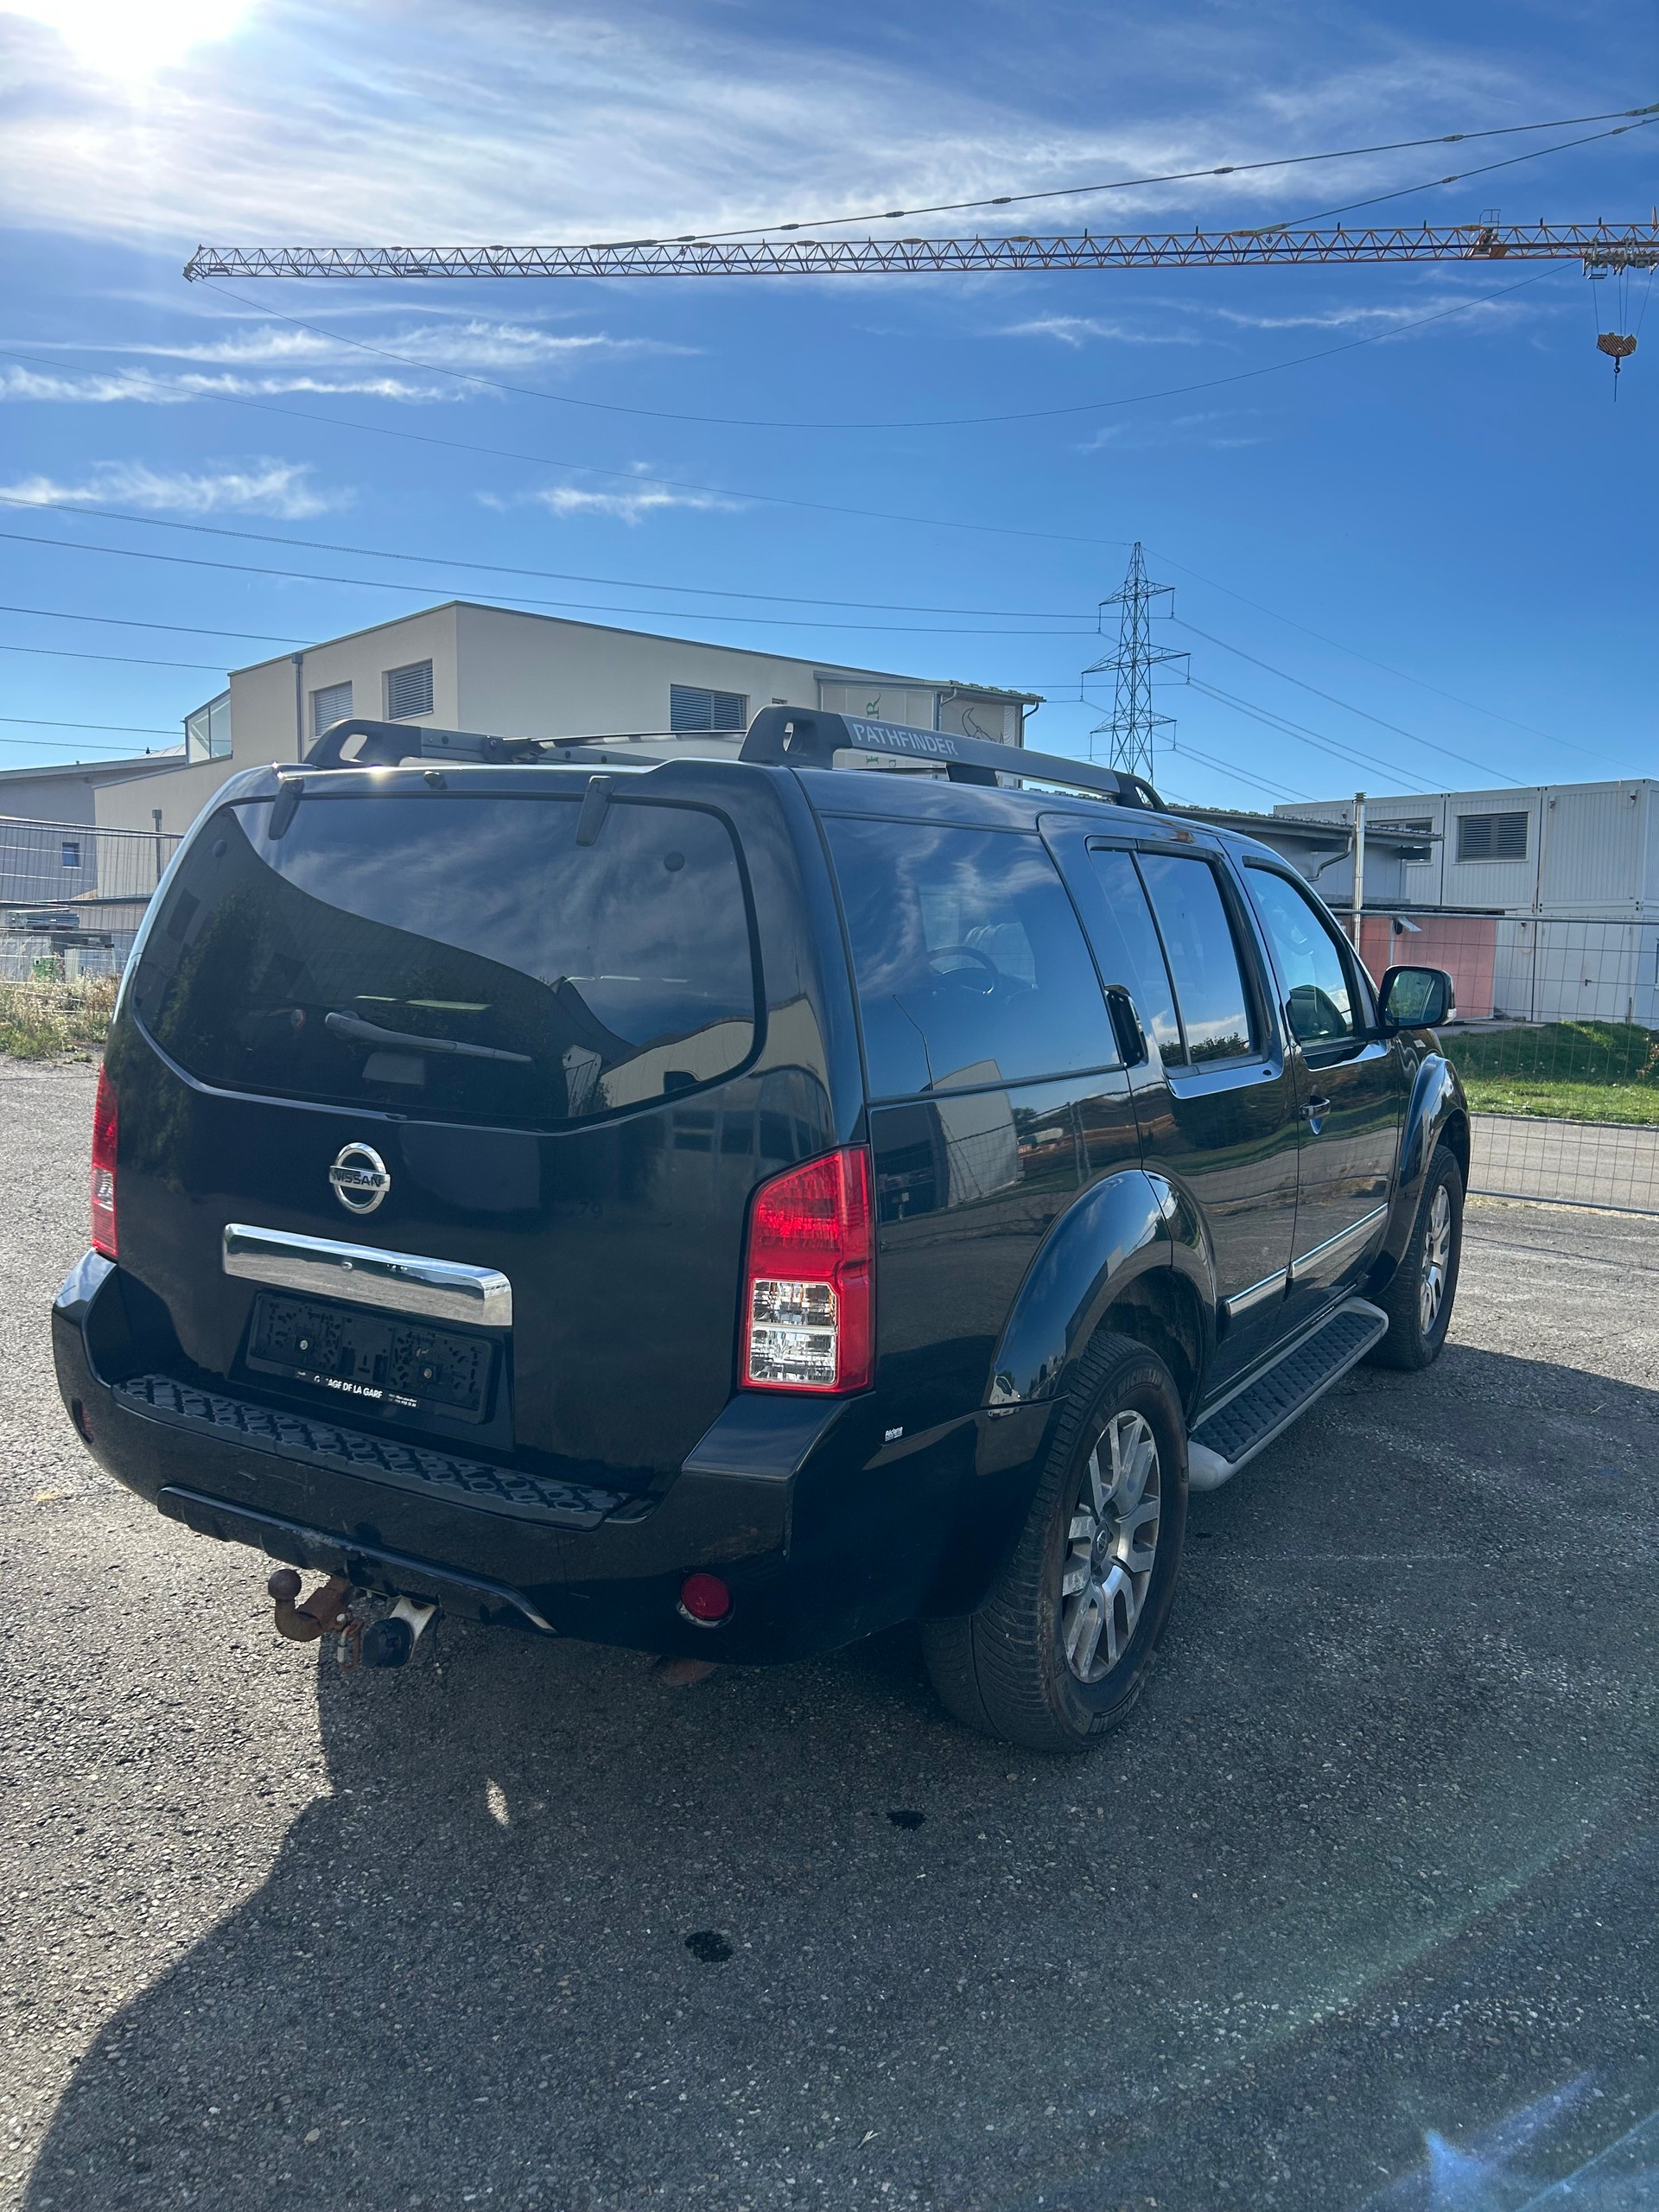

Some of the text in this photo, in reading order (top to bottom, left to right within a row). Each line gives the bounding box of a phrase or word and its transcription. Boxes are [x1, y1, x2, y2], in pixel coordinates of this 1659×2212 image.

[852, 723, 959, 756] PATHFINDER
[334, 1171, 381, 1187] NISSAN
[353, 1384, 363, 1395] LA
